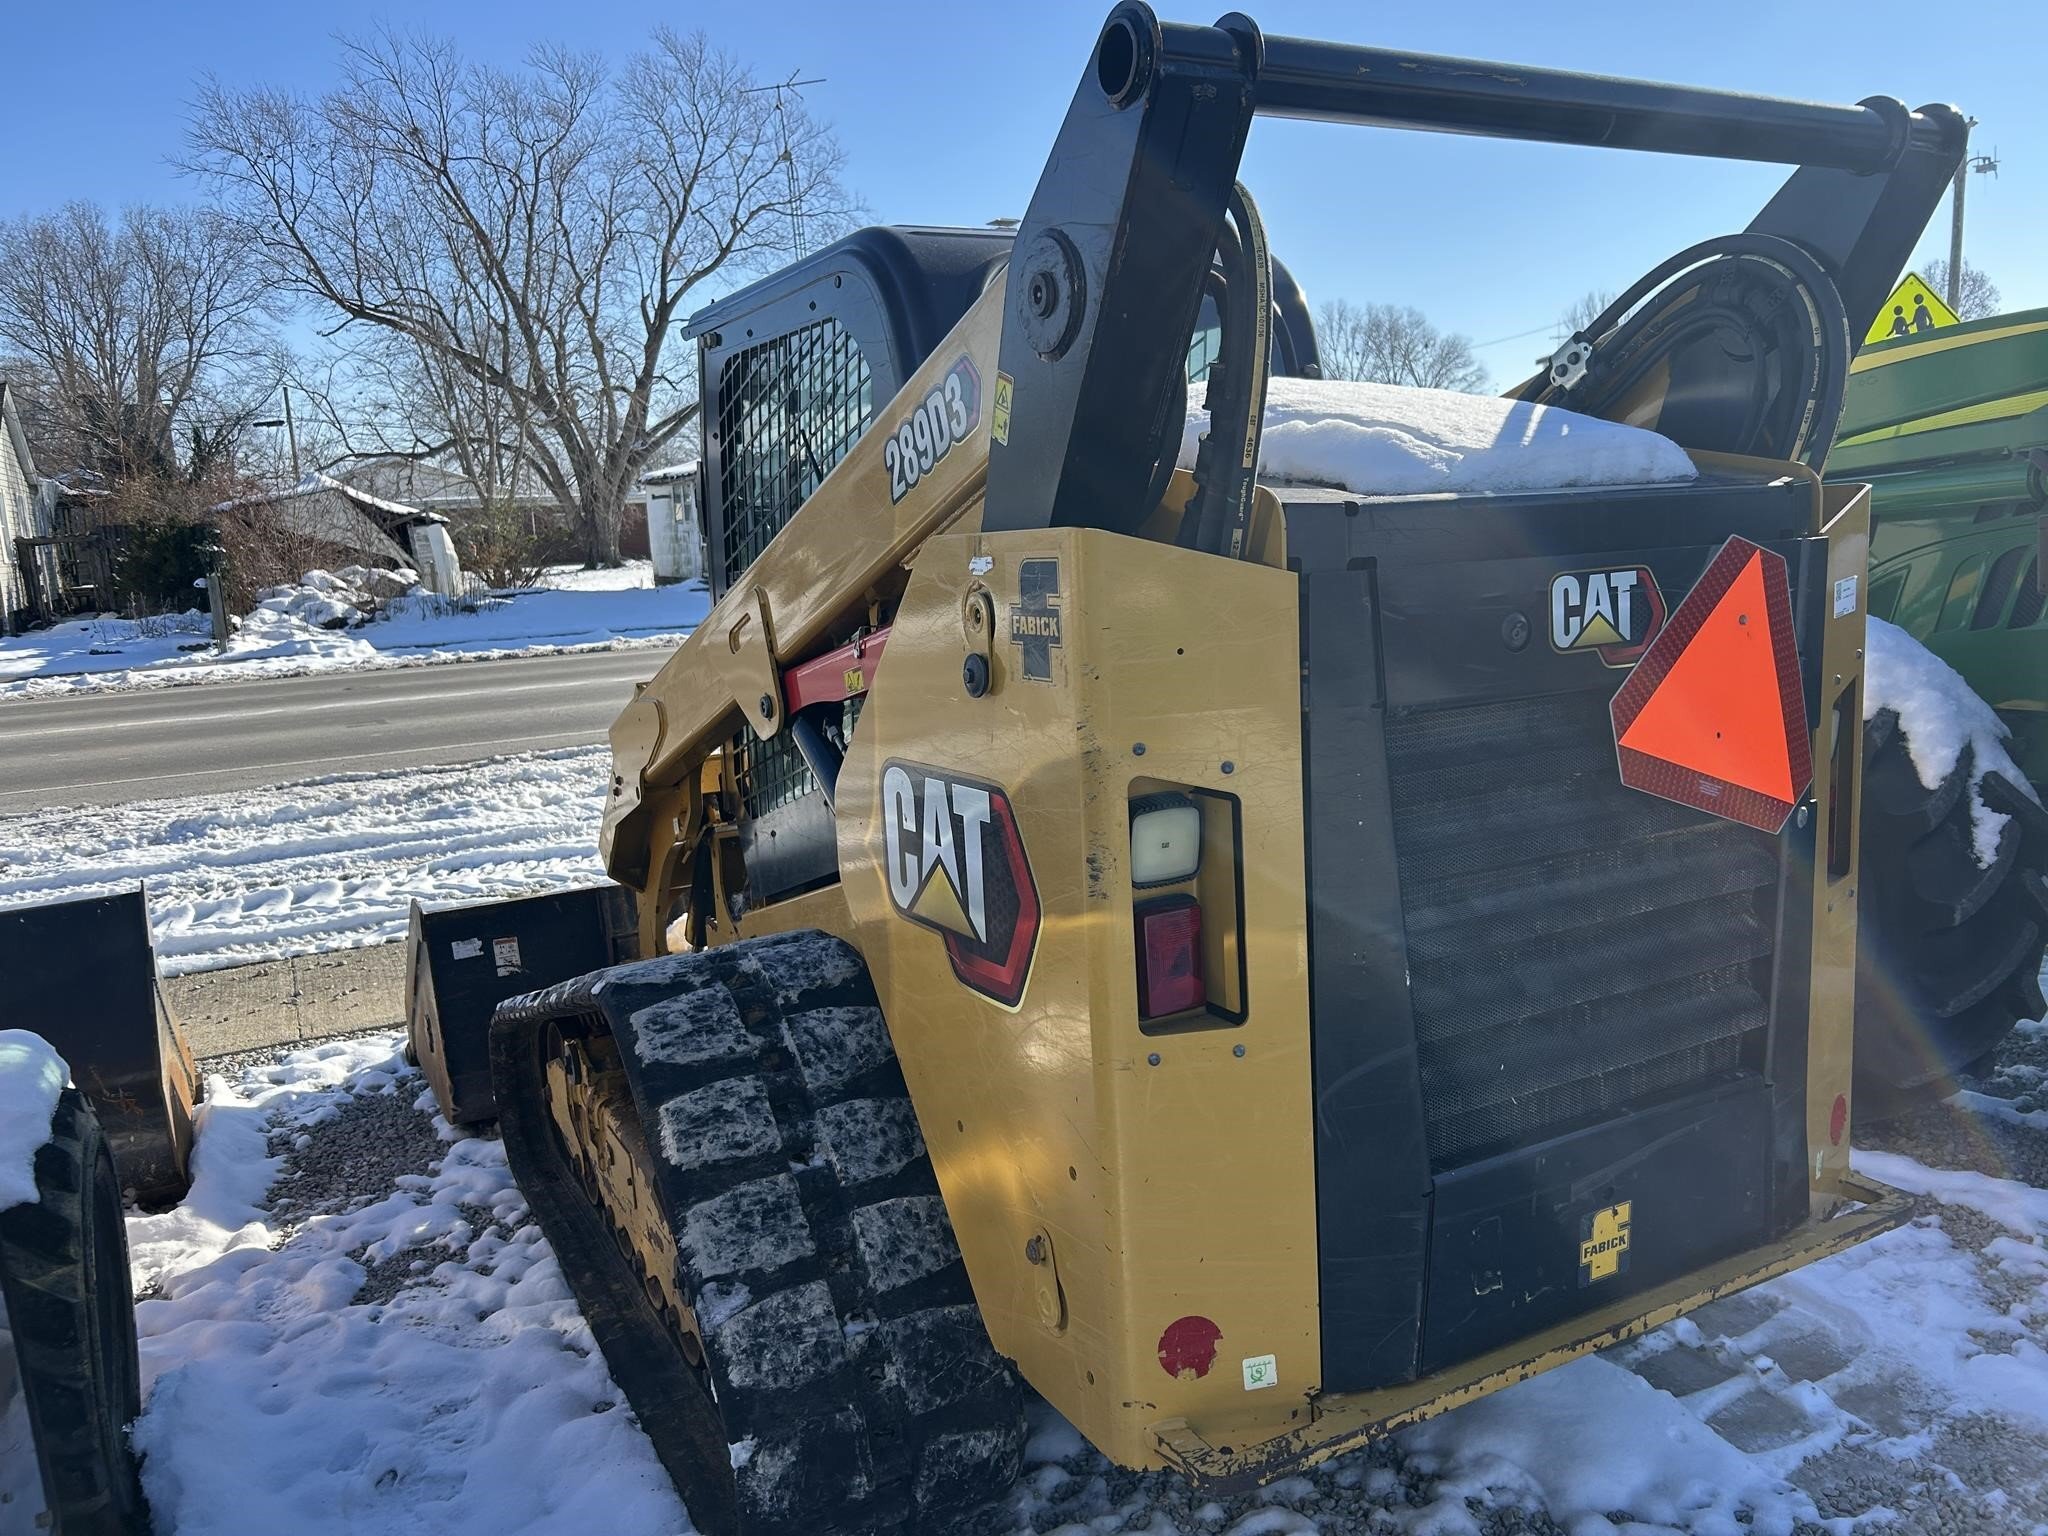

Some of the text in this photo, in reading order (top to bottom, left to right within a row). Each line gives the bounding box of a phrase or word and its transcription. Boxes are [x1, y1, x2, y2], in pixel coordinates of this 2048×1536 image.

[885, 373, 968, 501] 289D3
[1012, 615, 1059, 637] FABICK
[1551, 570, 1638, 648] CAT
[883, 766, 991, 944] CAT
[1583, 1233, 1627, 1260] FABICK
